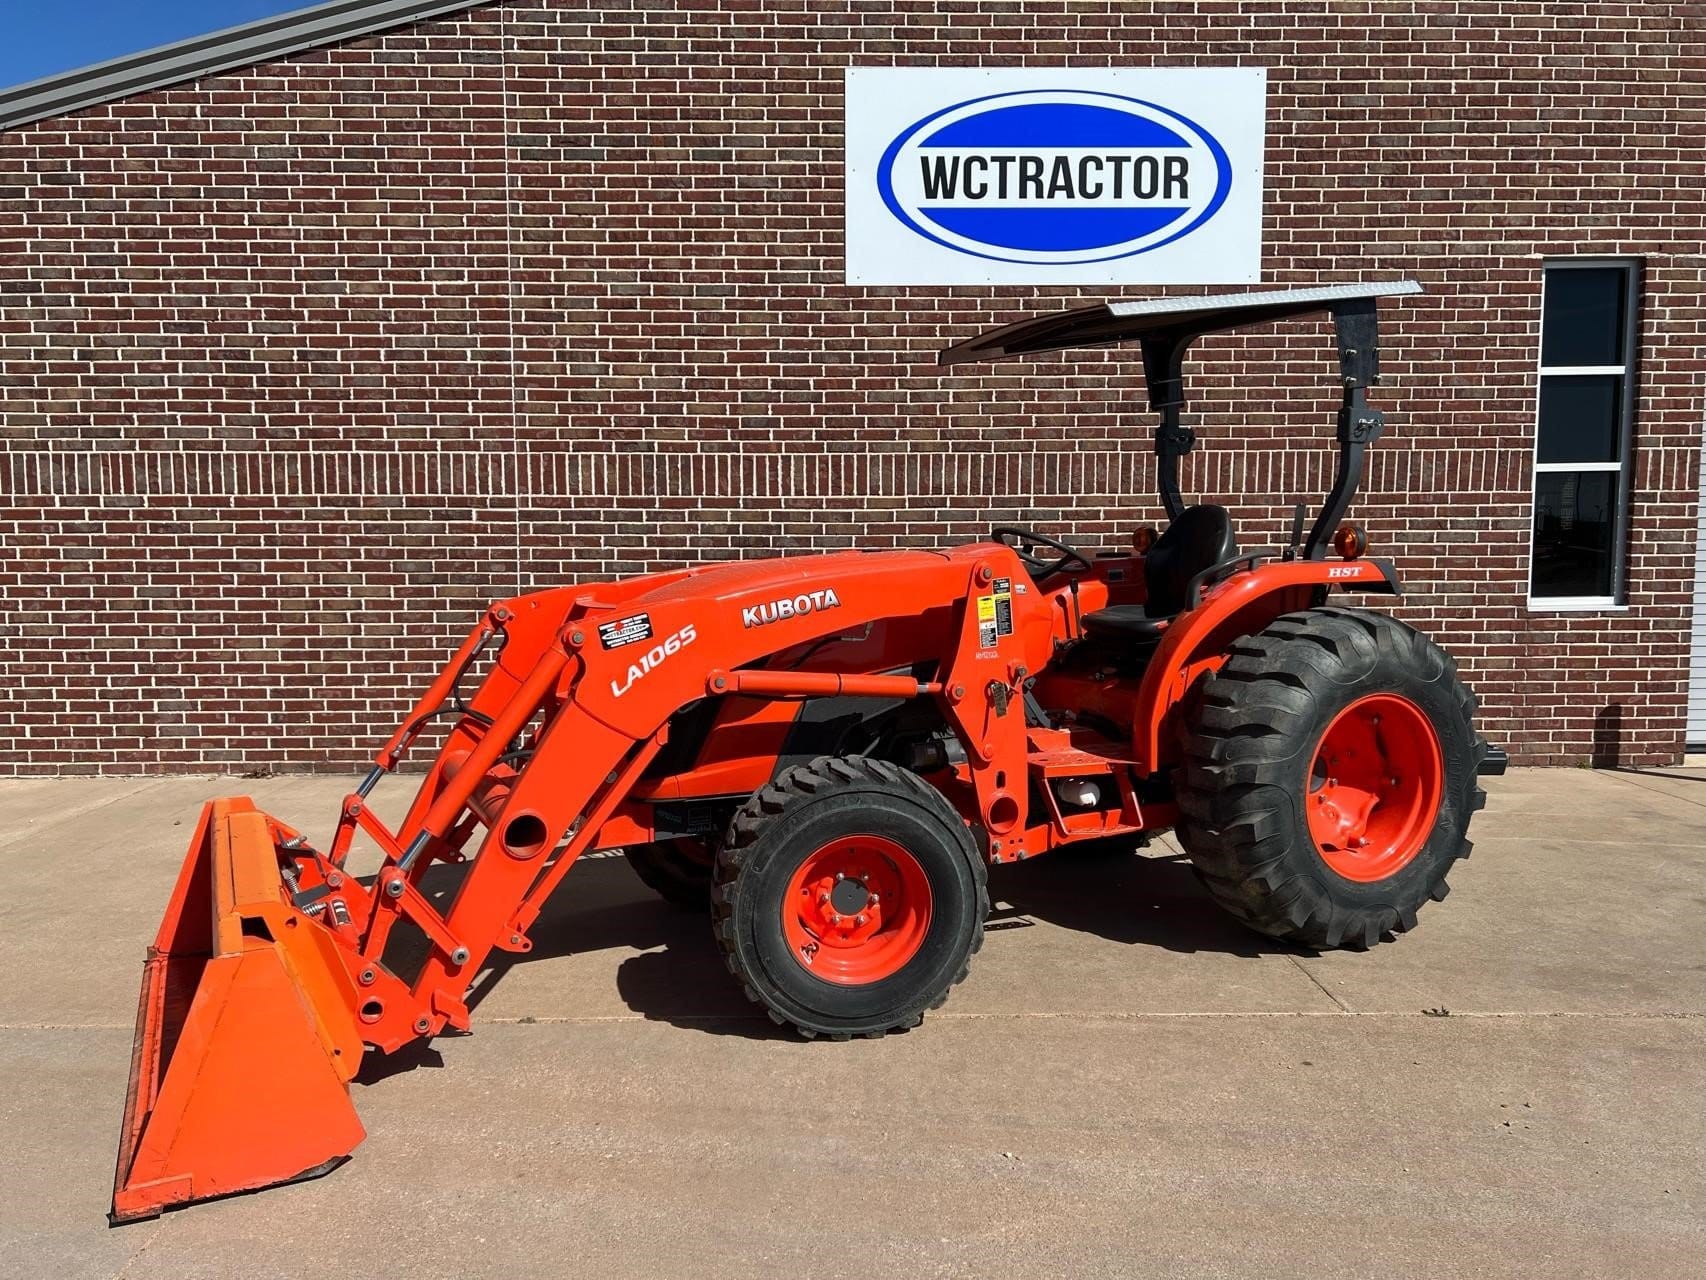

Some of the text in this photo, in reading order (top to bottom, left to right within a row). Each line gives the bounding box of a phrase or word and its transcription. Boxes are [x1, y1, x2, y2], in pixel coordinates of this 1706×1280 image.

[920, 155, 1189, 200] WCTRACTOR
[1328, 567, 1363, 578] HST
[741, 588, 841, 628] KUBOTA
[610, 623, 697, 698] LA1065
